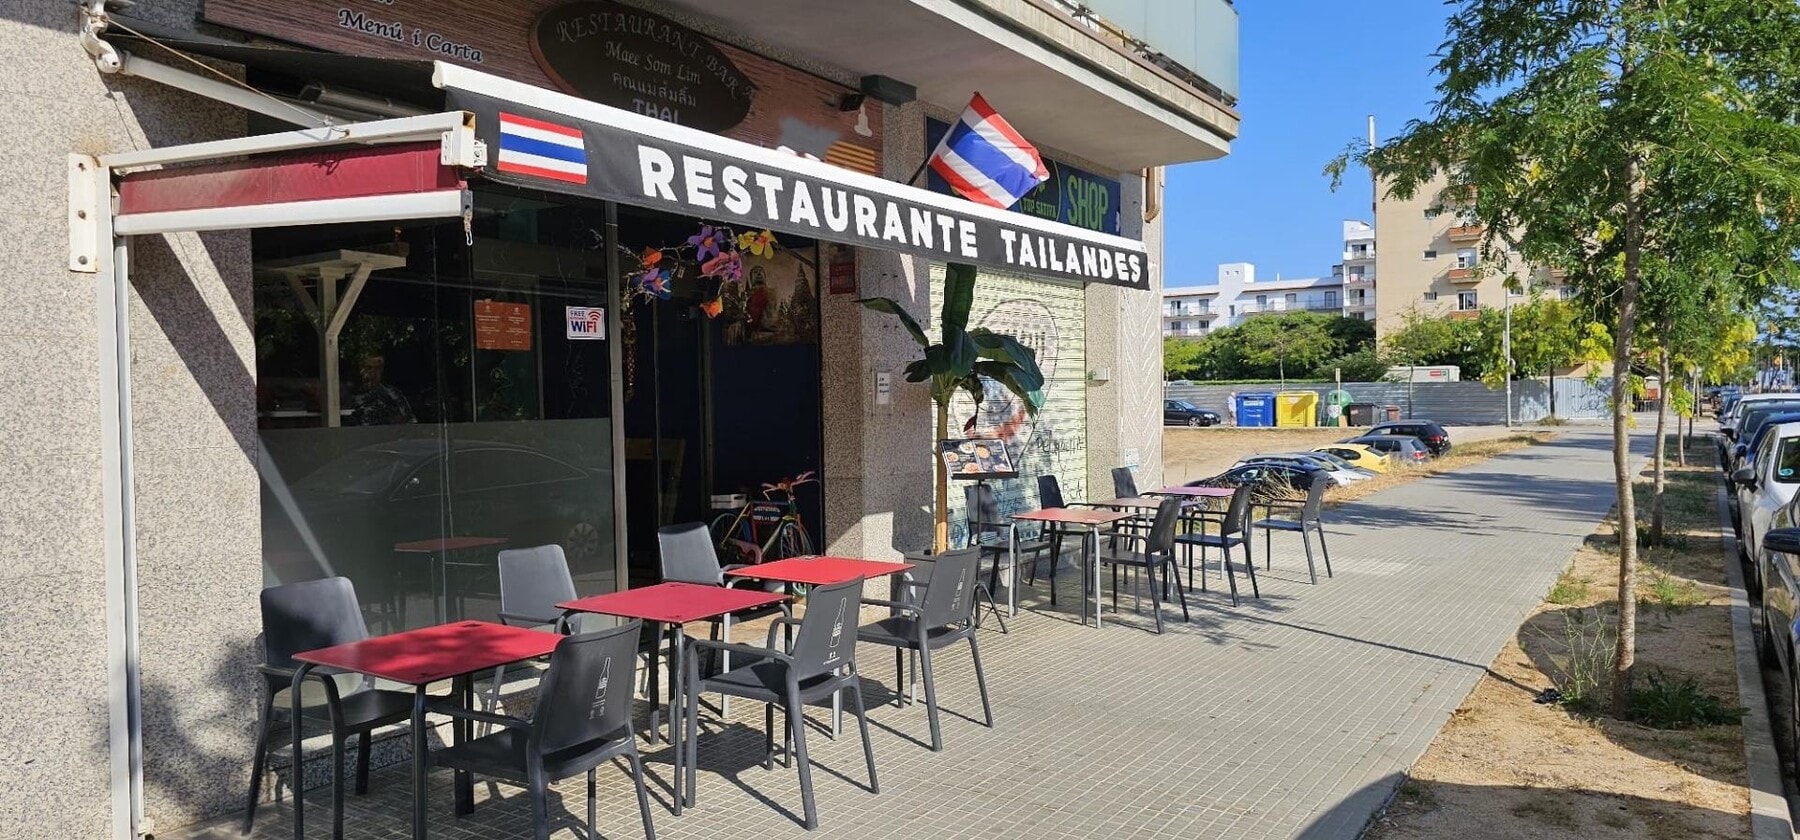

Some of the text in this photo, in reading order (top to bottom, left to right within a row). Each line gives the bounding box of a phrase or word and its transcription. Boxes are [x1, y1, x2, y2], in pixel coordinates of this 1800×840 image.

[338, 8, 404, 41] Menú
[425, 33, 483, 63] Carta
[605, 41, 701, 84] Maee Som Lim
[706, 55, 739, 98] BAR
[632, 99, 680, 124] THAI
[638, 145, 1141, 283] RESTAURANTE TAILANDES
[1023, 197, 1035, 213] TOP
[1067, 174, 1109, 231] SHOP
[571, 320, 597, 333] WiFi
